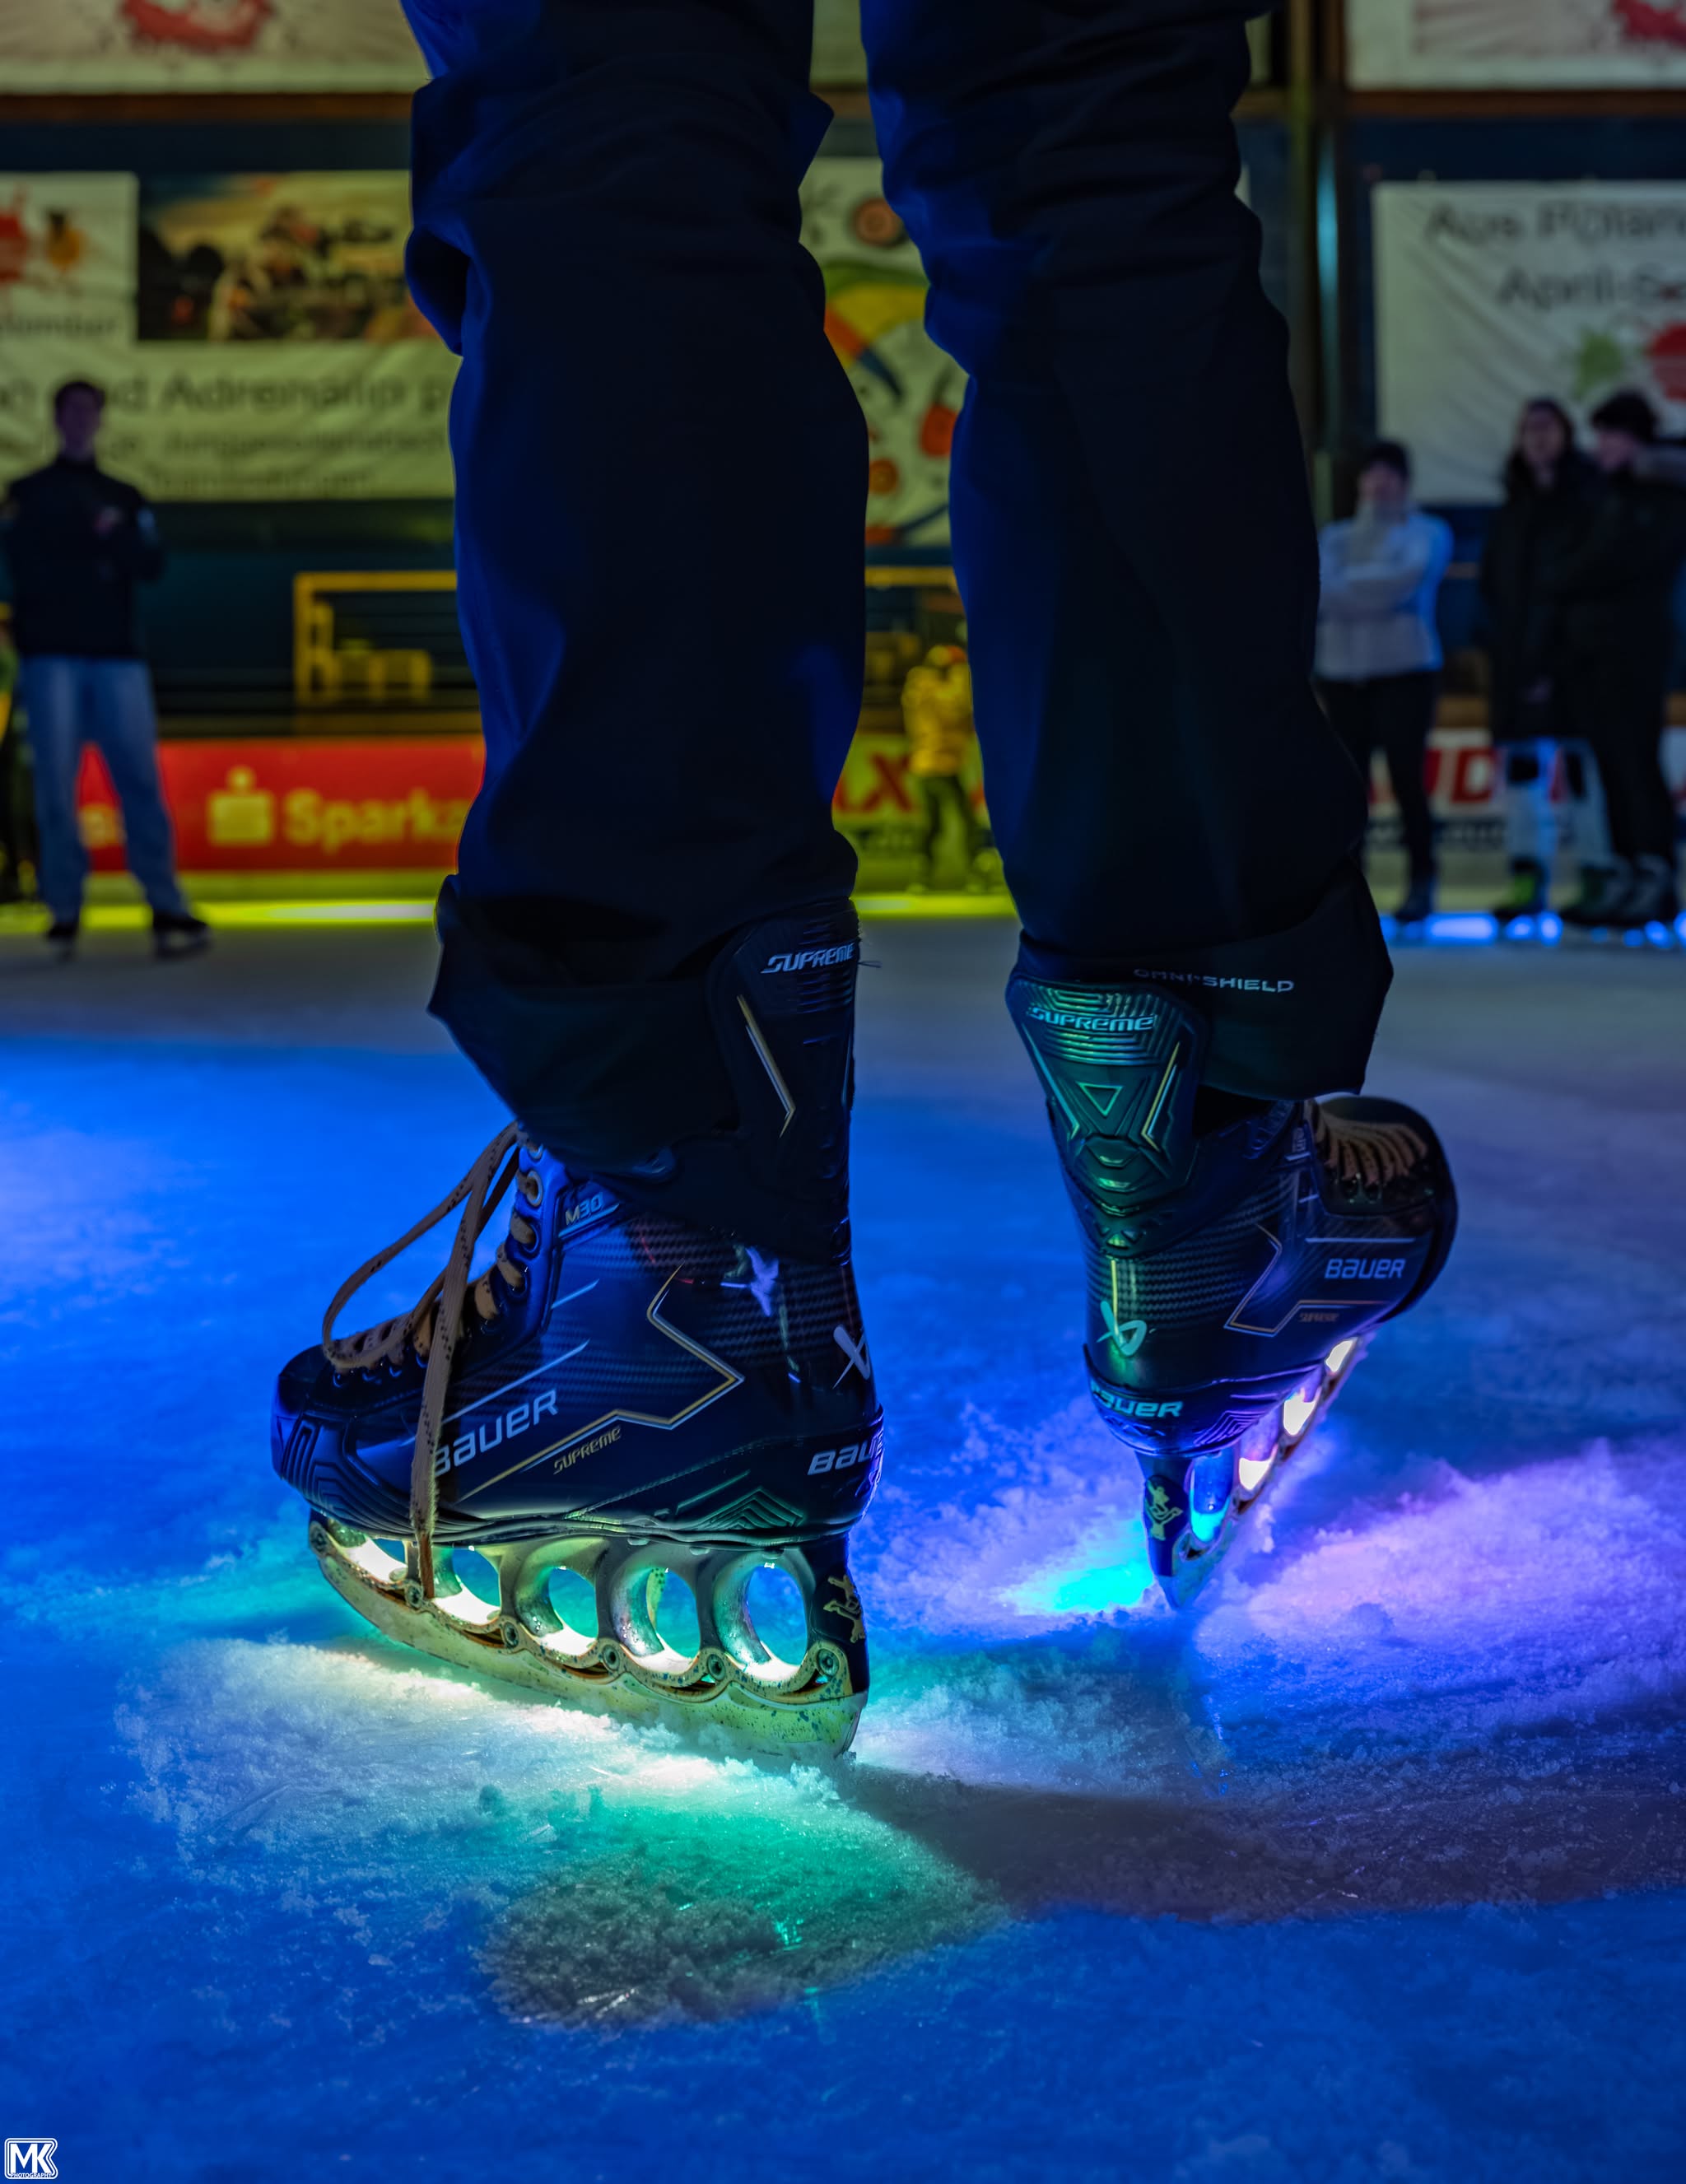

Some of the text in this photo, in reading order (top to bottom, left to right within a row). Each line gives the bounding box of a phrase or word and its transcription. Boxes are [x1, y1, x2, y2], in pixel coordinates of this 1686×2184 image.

[760, 941, 856, 974] SUPREME
[1029, 1006, 1156, 1031] SUPREME
[1324, 1257, 1407, 1279] BAUER
[435, 1388, 559, 1479] BAUER
[552, 1424, 622, 1475] SUPREME
